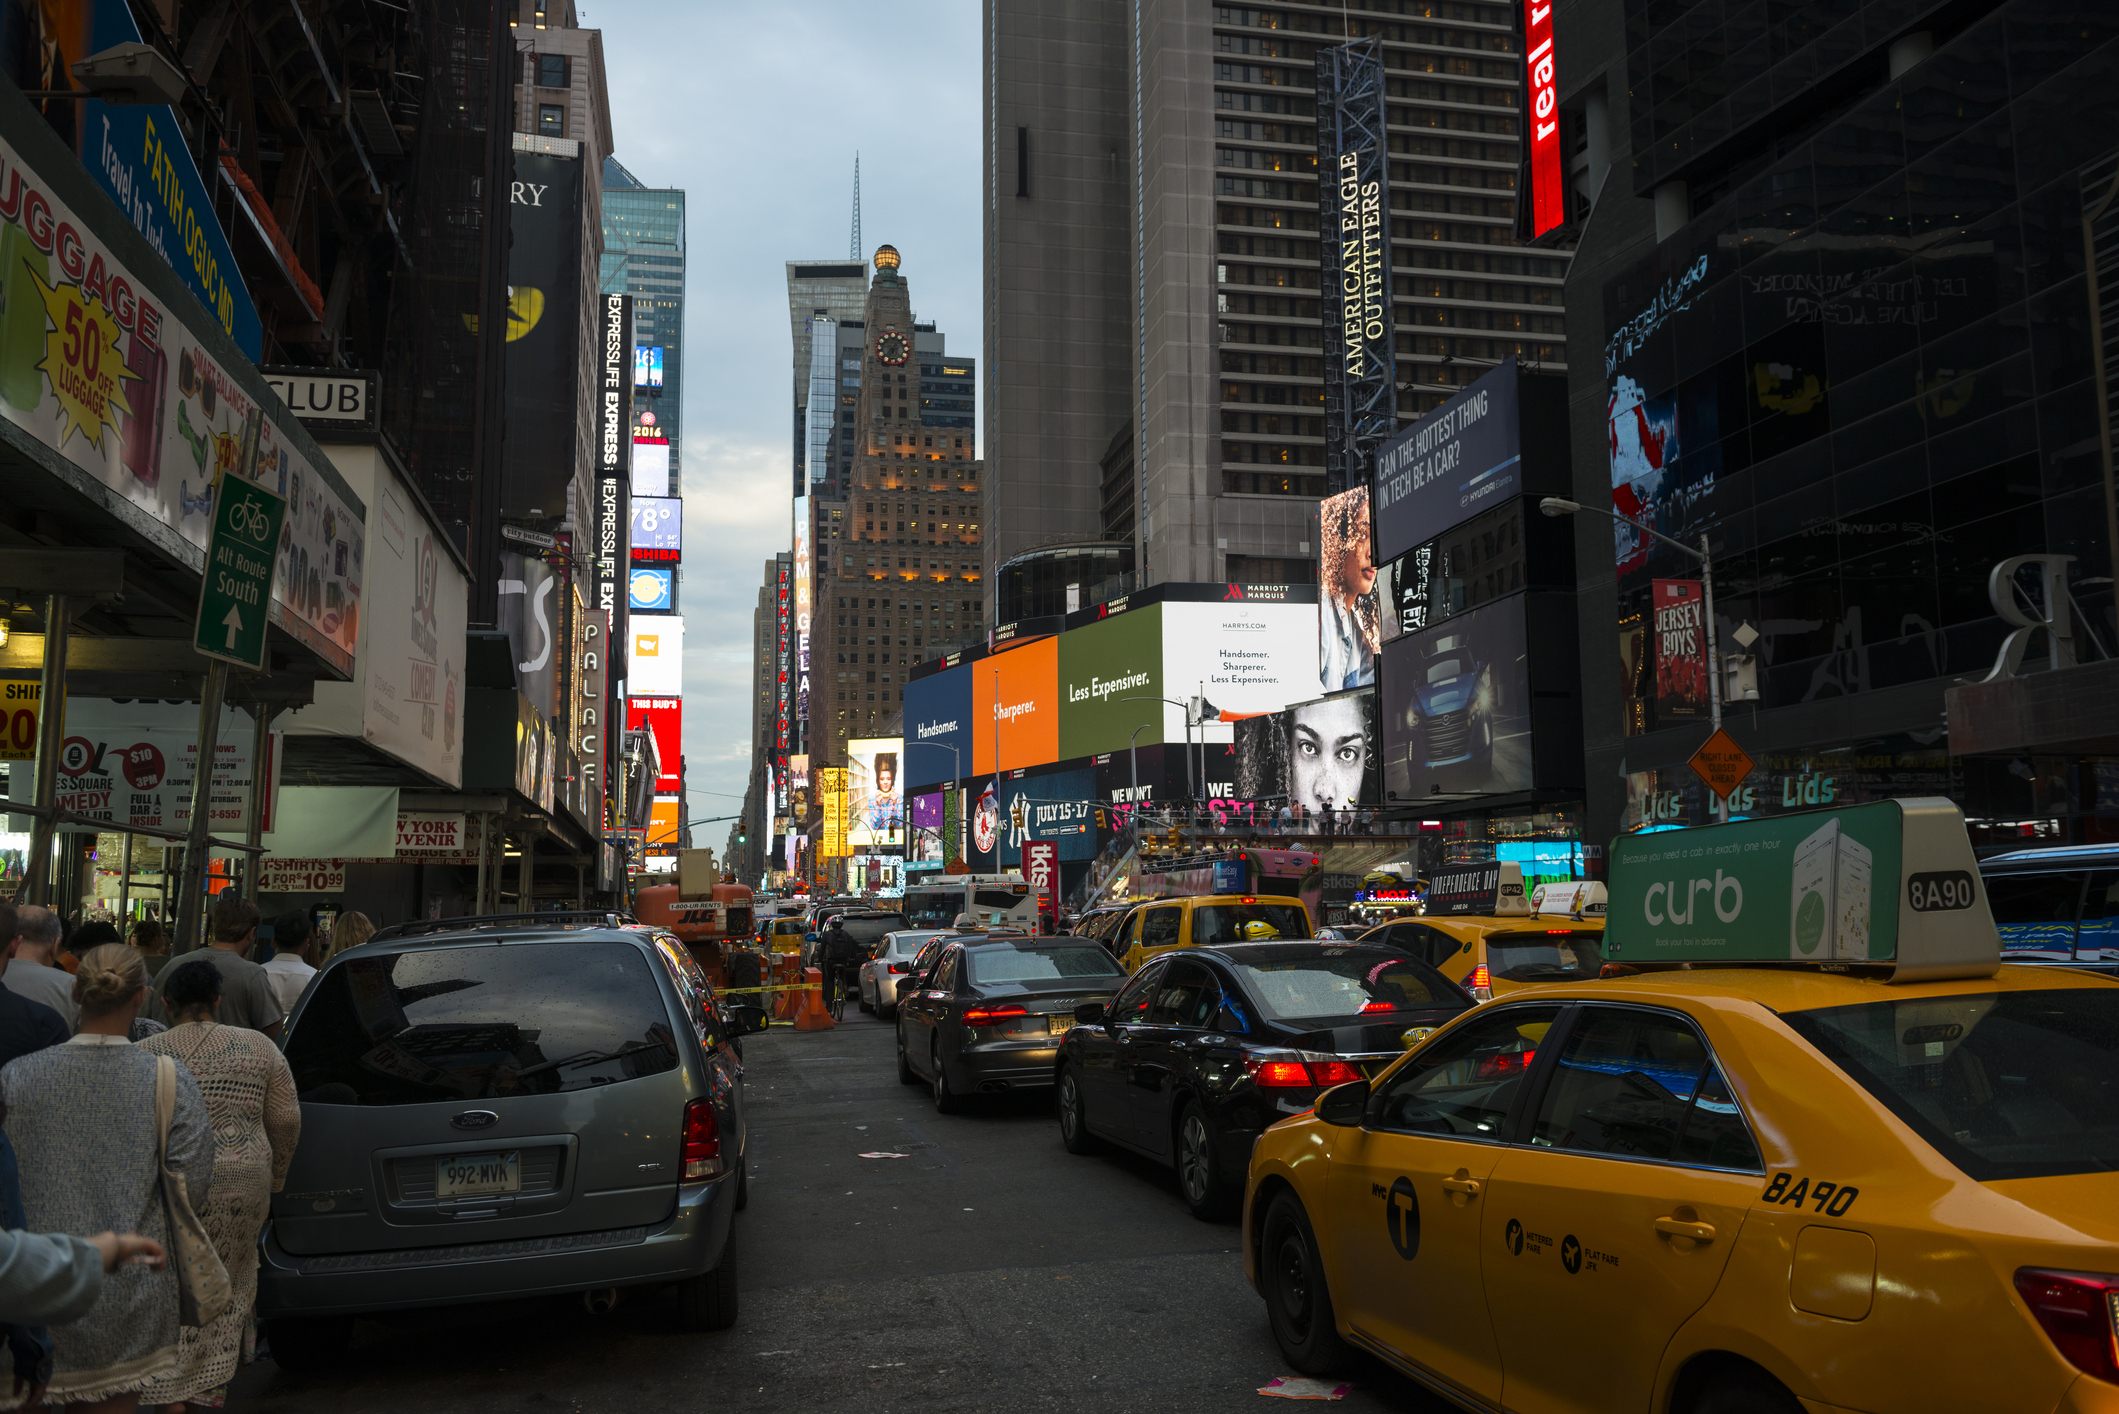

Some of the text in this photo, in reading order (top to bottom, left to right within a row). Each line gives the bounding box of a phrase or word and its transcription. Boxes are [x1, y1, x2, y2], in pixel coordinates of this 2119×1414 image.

[1528, 37, 1555, 141] real
[101, 114, 144, 232] Travel to
[143, 114, 184, 235] FATIH
[185, 207, 218, 301] OGUC
[1340, 151, 1364, 379] AMERICAN EAGLE
[1361, 181, 1384, 341] OUTFITTERS
[63, 299, 100, 382] 50
[59, 363, 105, 420] LUGGAGE
[98, 371, 114, 397] OFF
[193, 346, 246, 418] SMART BALANCE
[603, 392, 619, 468] EXPRESS
[633, 426, 662, 438] 2016
[1379, 388, 1489, 481] CAN THE HOTTEST THING
[634, 437, 669, 446] OSHIBA
[1380, 439, 1461, 511] IN TECH BE A CAR?
[1470, 474, 1513, 503] HYUNDAI Elantra
[640, 499, 657, 507] Now
[337, 507, 351, 527] SONY
[507, 529, 552, 545] city outdoor
[630, 548, 680, 561] SHIBA
[797, 520, 810, 580] PAM
[216, 546, 267, 581] Alt Route
[216, 571, 259, 607] South
[798, 586, 809, 605] &
[1248, 592, 1285, 600] MARQUIS
[1108, 595, 1129, 607] MARRIOTT
[1108, 603, 1127, 614] MARQUIS
[1655, 602, 1701, 633] JERSEY
[423, 620, 438, 663] SQUARE
[1662, 628, 1697, 657] BOYS
[1219, 649, 1270, 659] Handsomer.
[1223, 661, 1267, 674] Sharperer.
[410, 661, 437, 702] COMEDY
[777, 570, 788, 787] ERNST & YOUNG
[1069, 669, 1150, 703] Less Expensiver.
[1211, 674, 1279, 687] Less Expensiver.
[582, 624, 599, 781] PALACE
[632, 699, 677, 710] THIS BUD'S
[994, 700, 1036, 723] Sharperer.
[421, 702, 435, 741] CLUB
[918, 719, 958, 740] Handsomer.
[1, 750, 26, 759] Each
[130, 748, 153, 764] $10
[1700, 752, 1743, 763] RIGHT LANE
[1708, 763, 1737, 773] CLOSED
[69, 775, 114, 792] SQUARE
[136, 774, 159, 788] 3PM
[1710, 773, 1736, 784] AHEAD
[1111, 789, 1125, 804] WE
[1207, 783, 1234, 798] WE
[1782, 771, 1837, 808] Lids
[130, 794, 153, 805] FULL
[1641, 790, 1683, 823] Lids
[130, 805, 151, 815] BAR
[1036, 804, 1058, 827] JULY
[1059, 800, 1089, 820] 15-17
[129, 816, 162, 826] INSIDE
[411, 821, 458, 834] YORK
[1622, 839, 1782, 865] Because you need a cab in exactly one hour
[1030, 845, 1050, 888] tkts
[258, 873, 297, 889] 4 FOR
[1430, 868, 1499, 896] INDEPENDENCE DAY
[1501, 884, 1523, 895] 6P42
[1435, 891, 1490, 902] RESURGENCE
[1644, 868, 1744, 927] curb
[1910, 878, 1971, 910] 8A90
[669, 902, 723, 911] 1-800-UR-RENTS
[678, 909, 716, 924] JLG
[1655, 937, 1727, 949] Book your taxi in advance
[1826, 964, 1846, 972] VeriFone
[460, 1114, 488, 1127] Ford
[637, 1163, 665, 1172] SEL
[1372, 1183, 1388, 1202] NYC
[1762, 1172, 1860, 1218] 8A90
[1526, 1230, 1554, 1247] METERED
[1526, 1240, 1542, 1255] FARE
[1584, 1248, 1619, 1267] FLAT FARE
[1584, 1260, 1598, 1273] JFK
